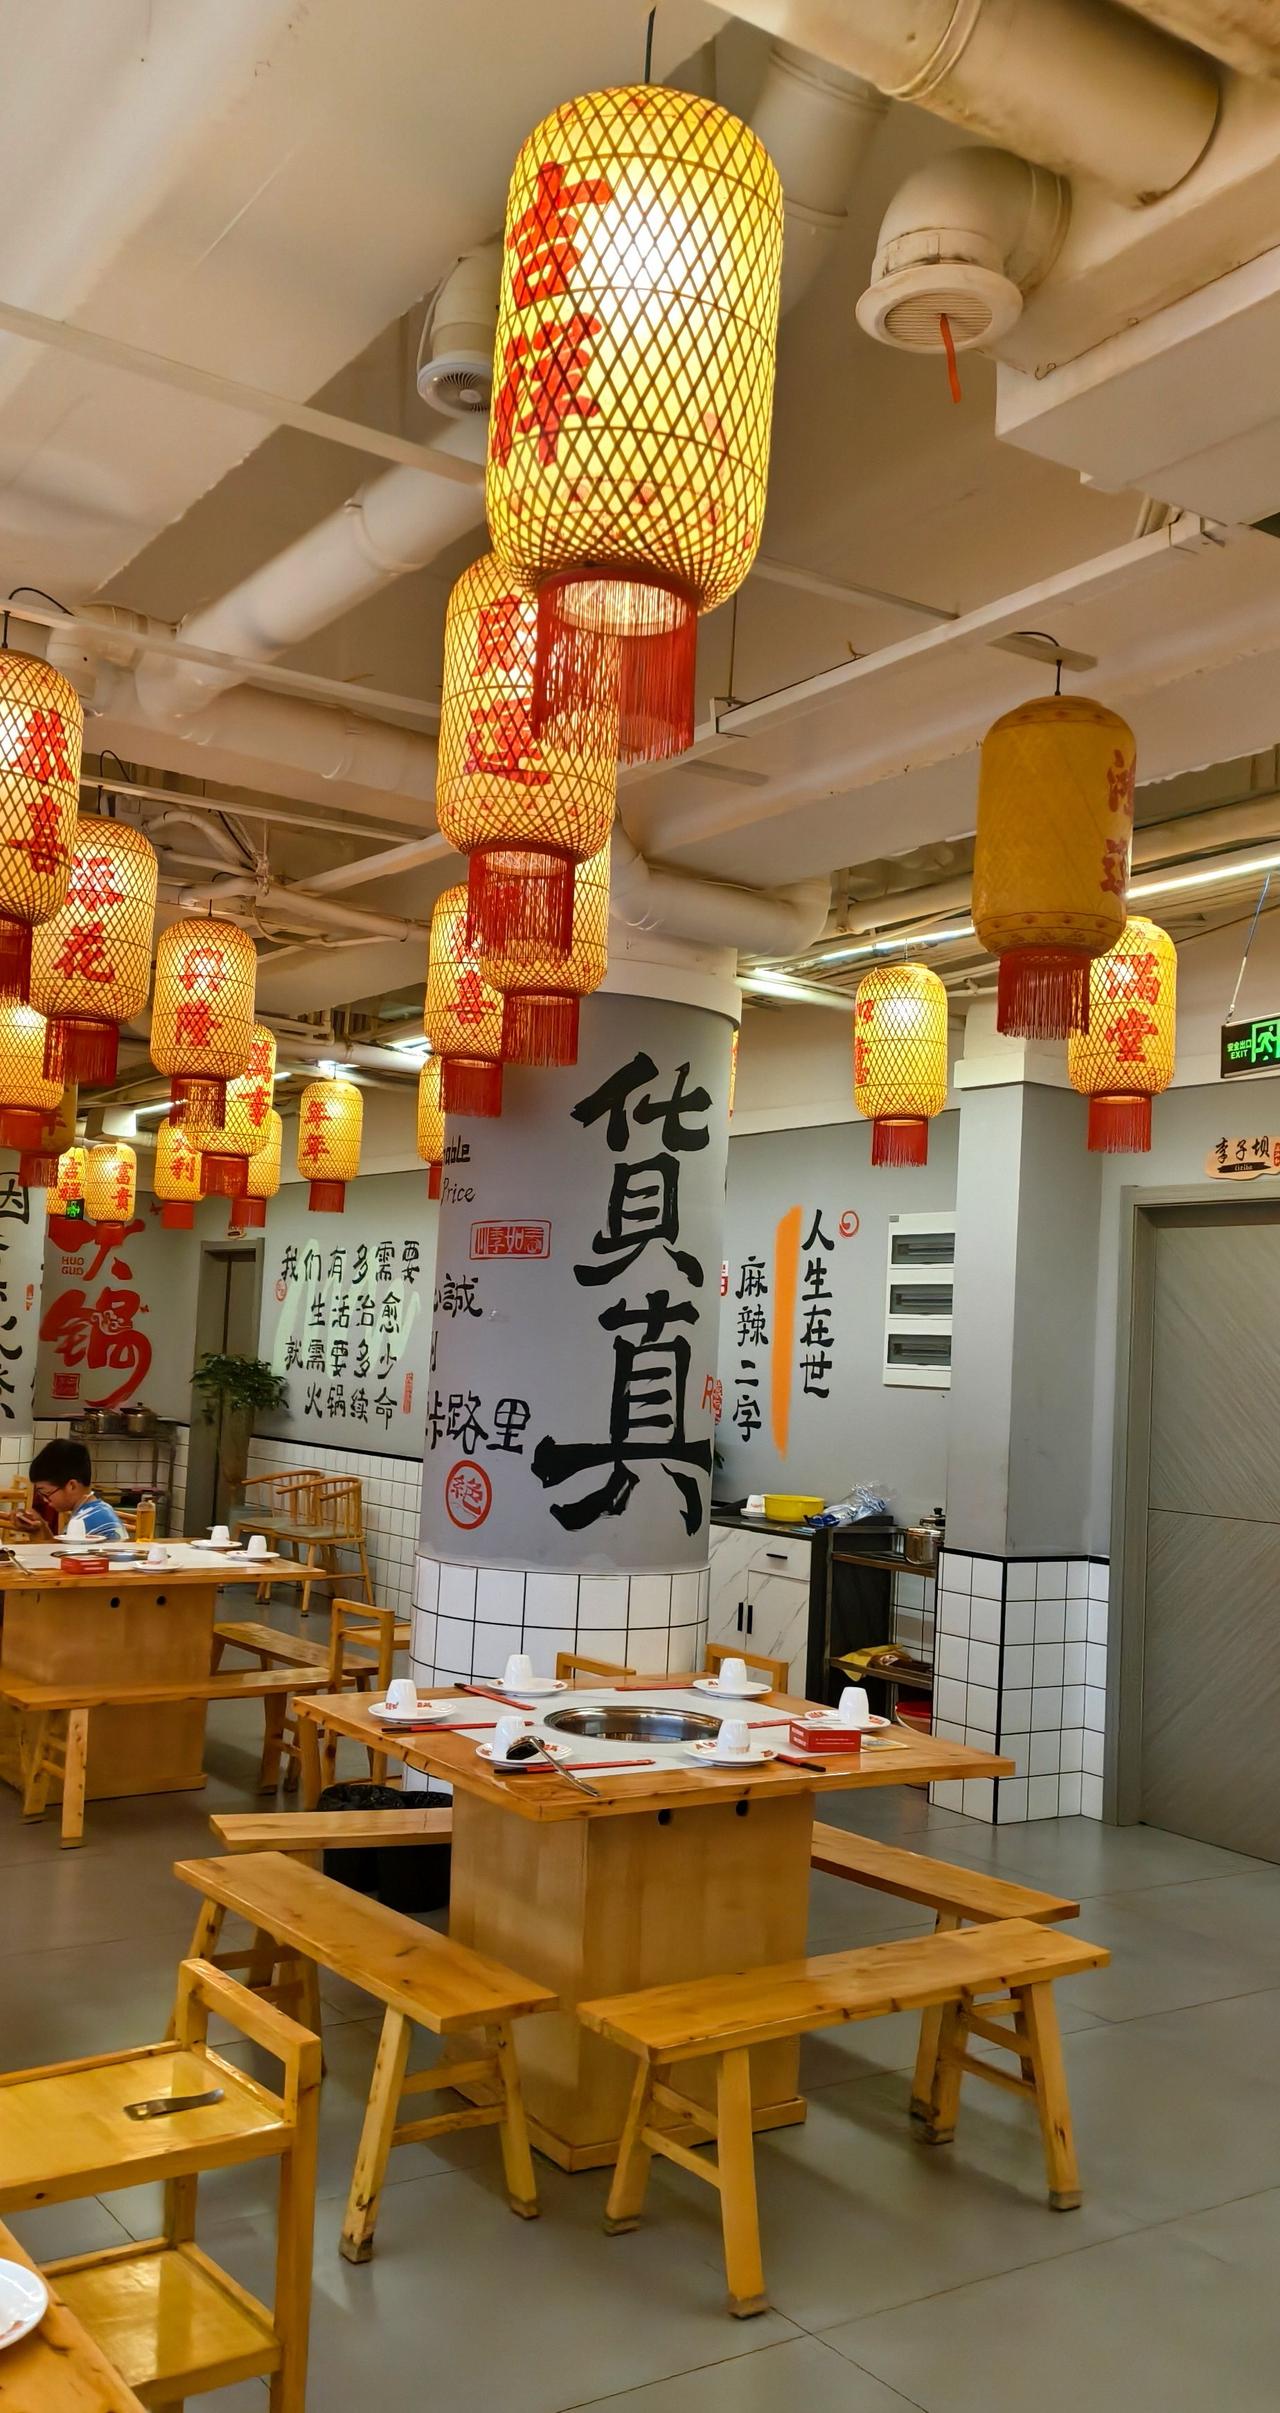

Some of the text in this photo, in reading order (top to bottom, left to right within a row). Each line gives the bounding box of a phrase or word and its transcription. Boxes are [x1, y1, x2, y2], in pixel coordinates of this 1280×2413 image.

[493, 160, 614, 468] 吉祥
[8, 708, 75, 876] 恭喜
[1227, 1039, 1251, 1052] 安全出口
[1230, 1049, 1248, 1060] EXIT
[1215, 1135, 1270, 1164] 李子坝
[441, 1177, 476, 1206] Price
[62, 1257, 84, 1266] HUO
[62, 1266, 84, 1275] GUO
[281, 1240, 421, 1284] 我们有多需要
[308, 1291, 401, 1333] 生活治愈
[800, 1208, 835, 1398] 人生在世
[284, 1336, 398, 1380] 就需要多少
[733, 1255, 769, 1442] 麻辣二字
[304, 1382, 398, 1431] 火锅续命
